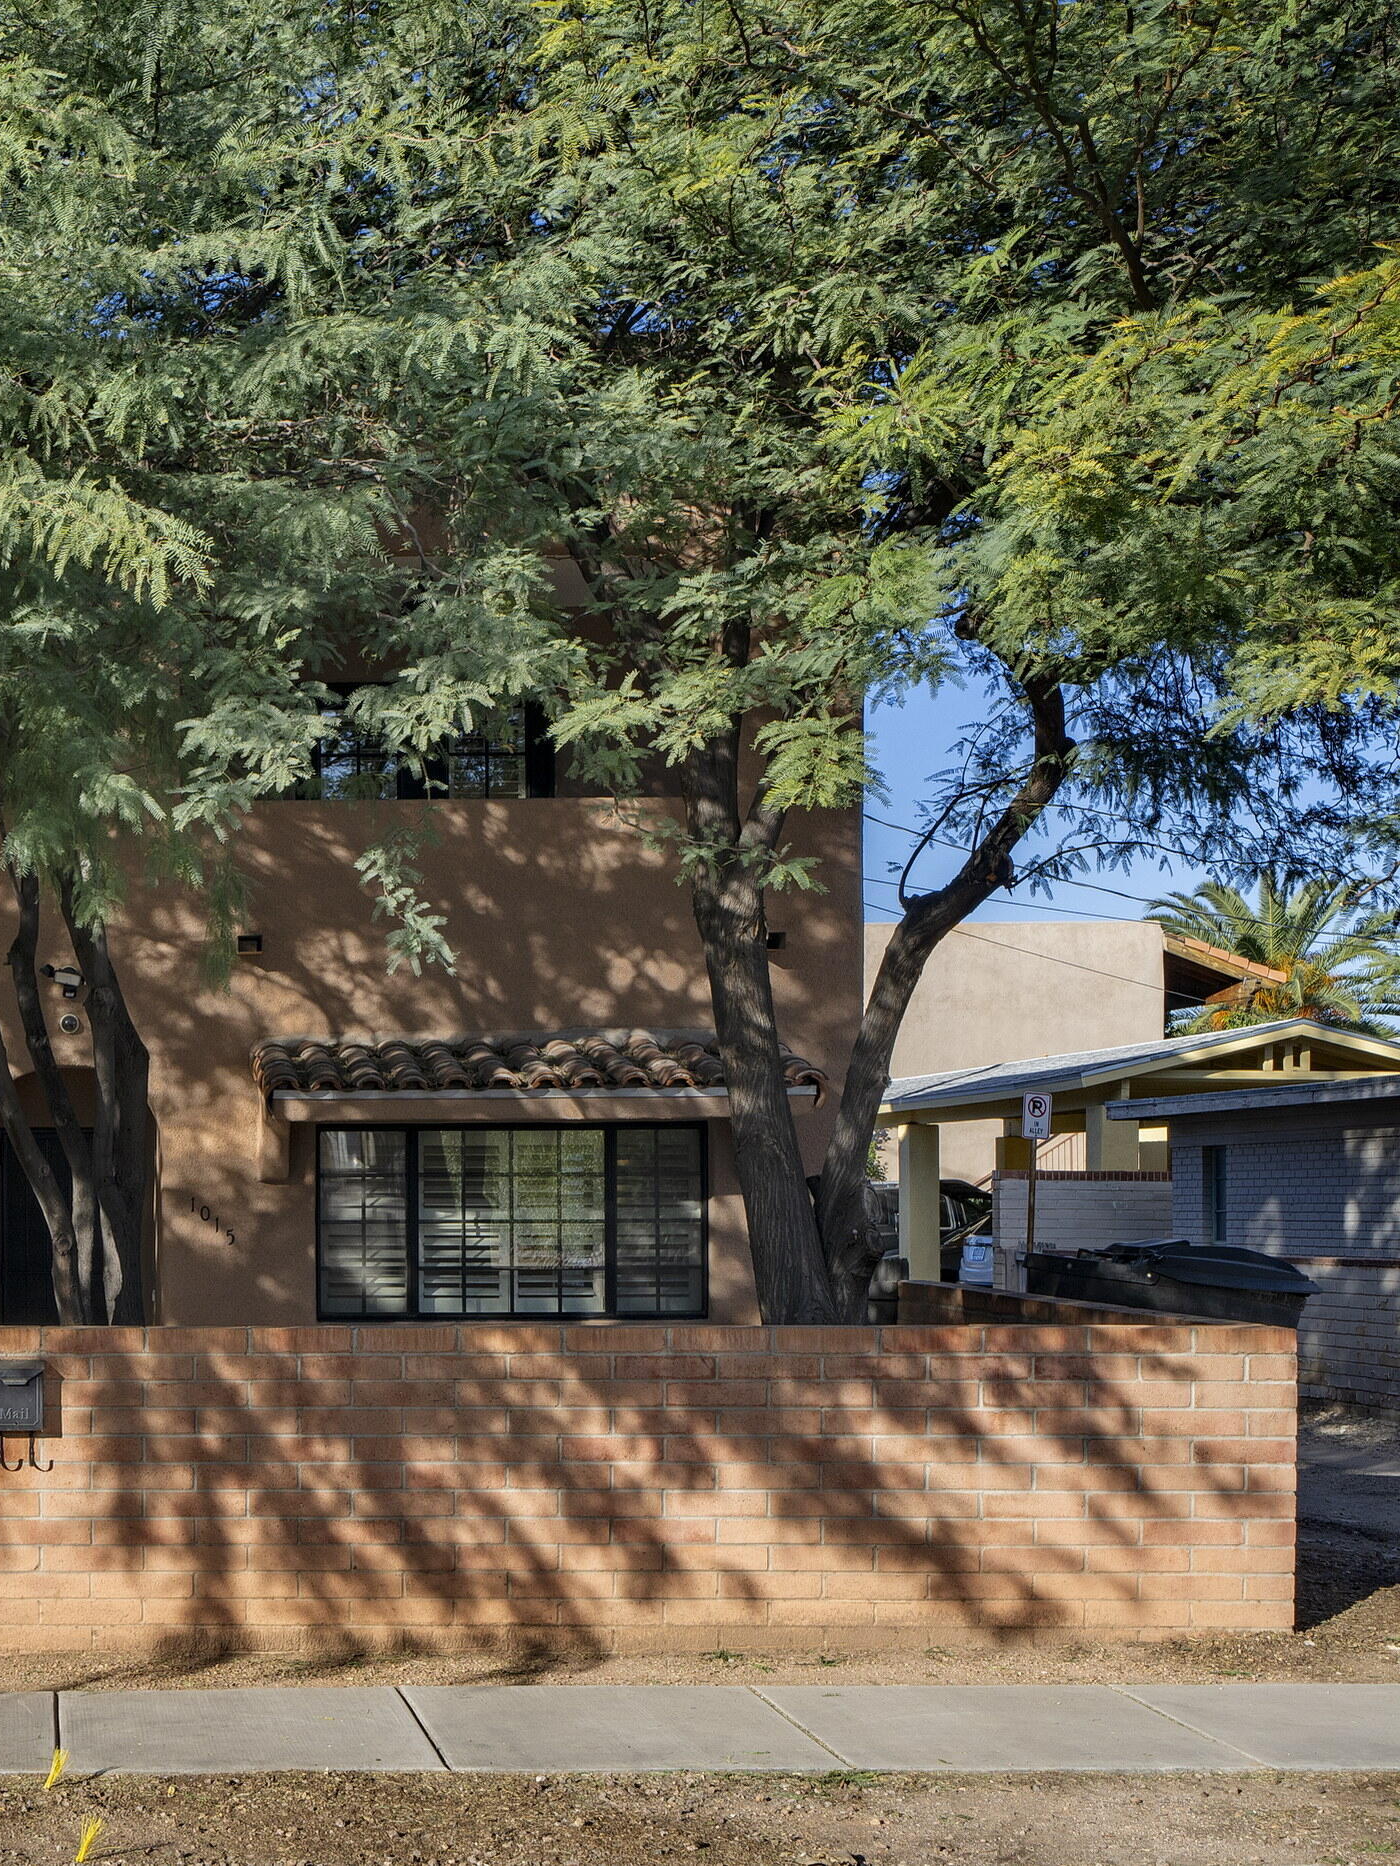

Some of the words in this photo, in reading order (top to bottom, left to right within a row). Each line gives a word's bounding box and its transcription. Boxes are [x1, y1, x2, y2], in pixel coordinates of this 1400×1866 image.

[1029, 1127, 1043, 1135] ALLEY
[191, 1197, 235, 1245] 1015
[0, 1407, 29, 1420] Mail
